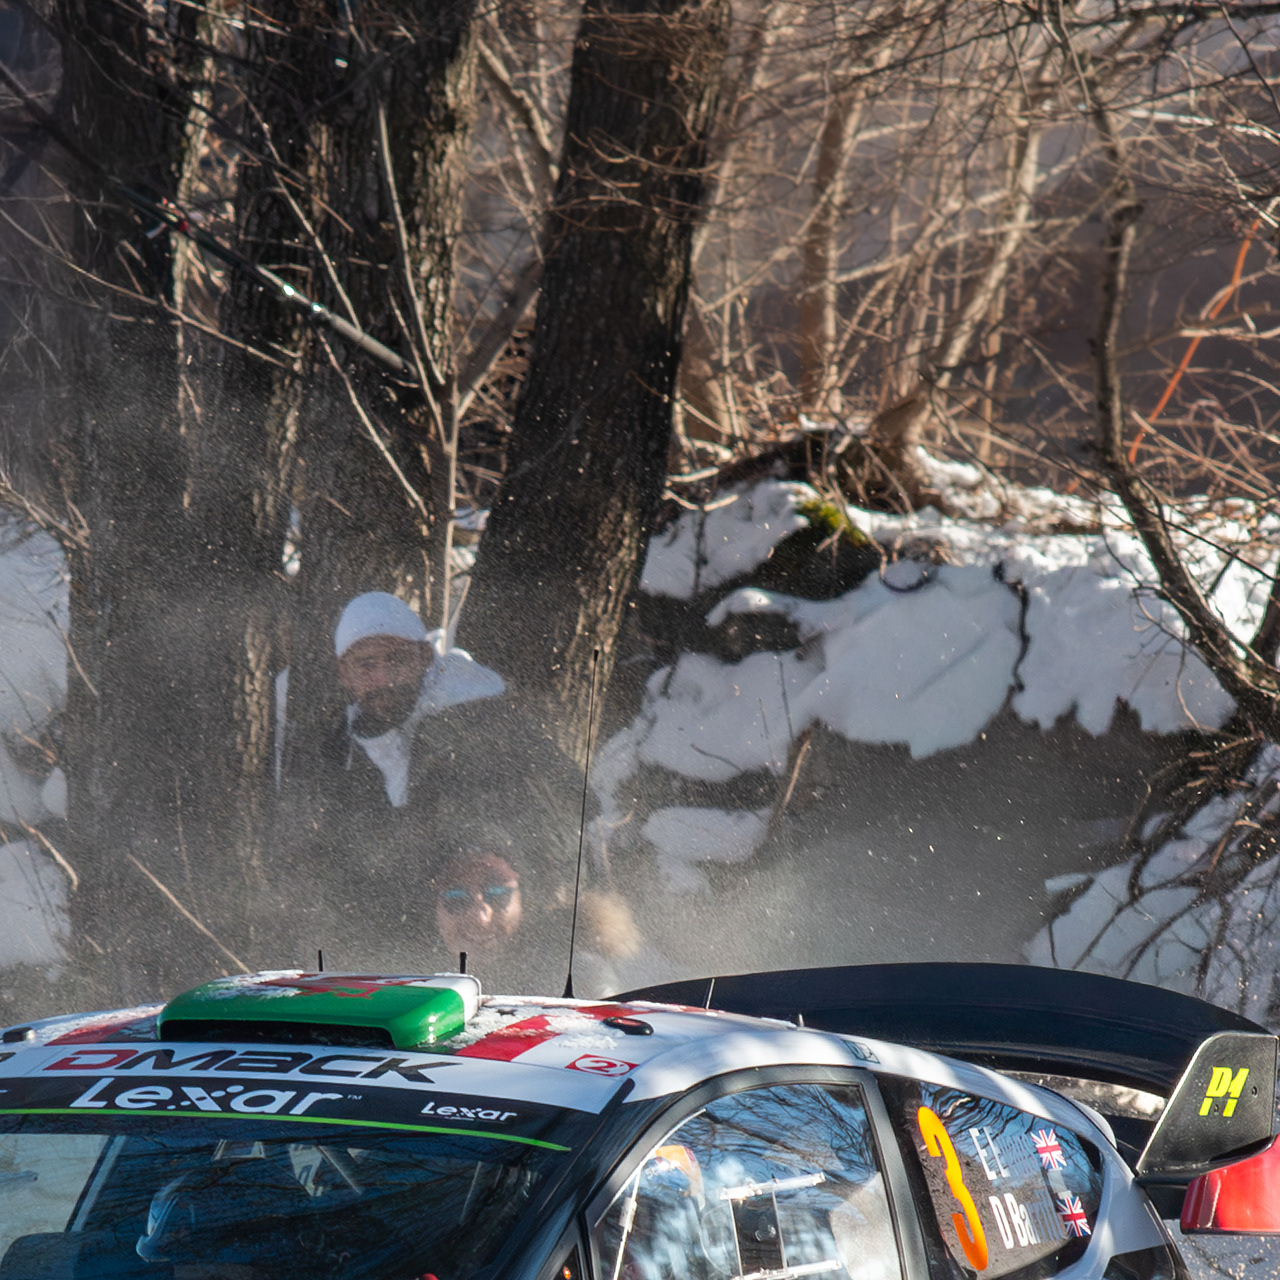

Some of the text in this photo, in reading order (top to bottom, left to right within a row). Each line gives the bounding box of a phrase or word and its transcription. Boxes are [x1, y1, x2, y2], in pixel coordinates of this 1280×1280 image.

[69, 1077, 344, 1116] Lexar
[420, 1101, 518, 1122] Lexar
[969, 1127, 997, 1181] E
[918, 1106, 988, 1271] 3
[989, 1195, 1015, 1250] D
